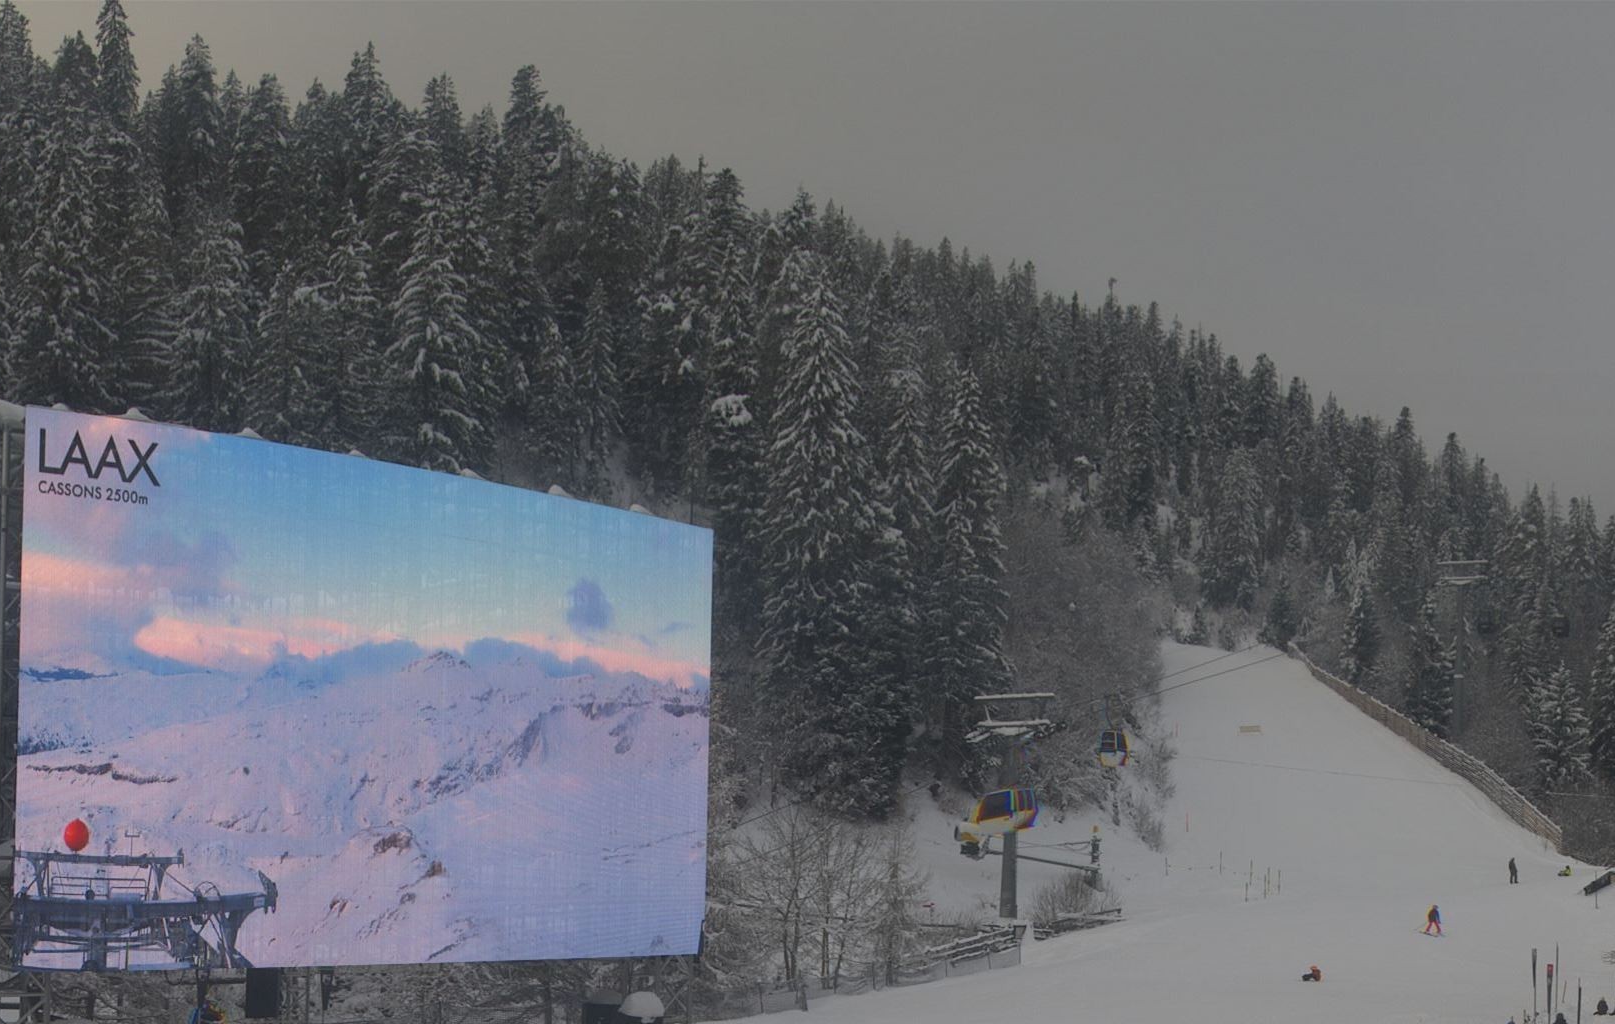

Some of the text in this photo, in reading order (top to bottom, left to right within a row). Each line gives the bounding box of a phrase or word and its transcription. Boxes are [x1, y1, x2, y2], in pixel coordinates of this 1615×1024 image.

[39, 428, 160, 486] LAAX
[38, 480, 149, 505] CASSONS 2500m
